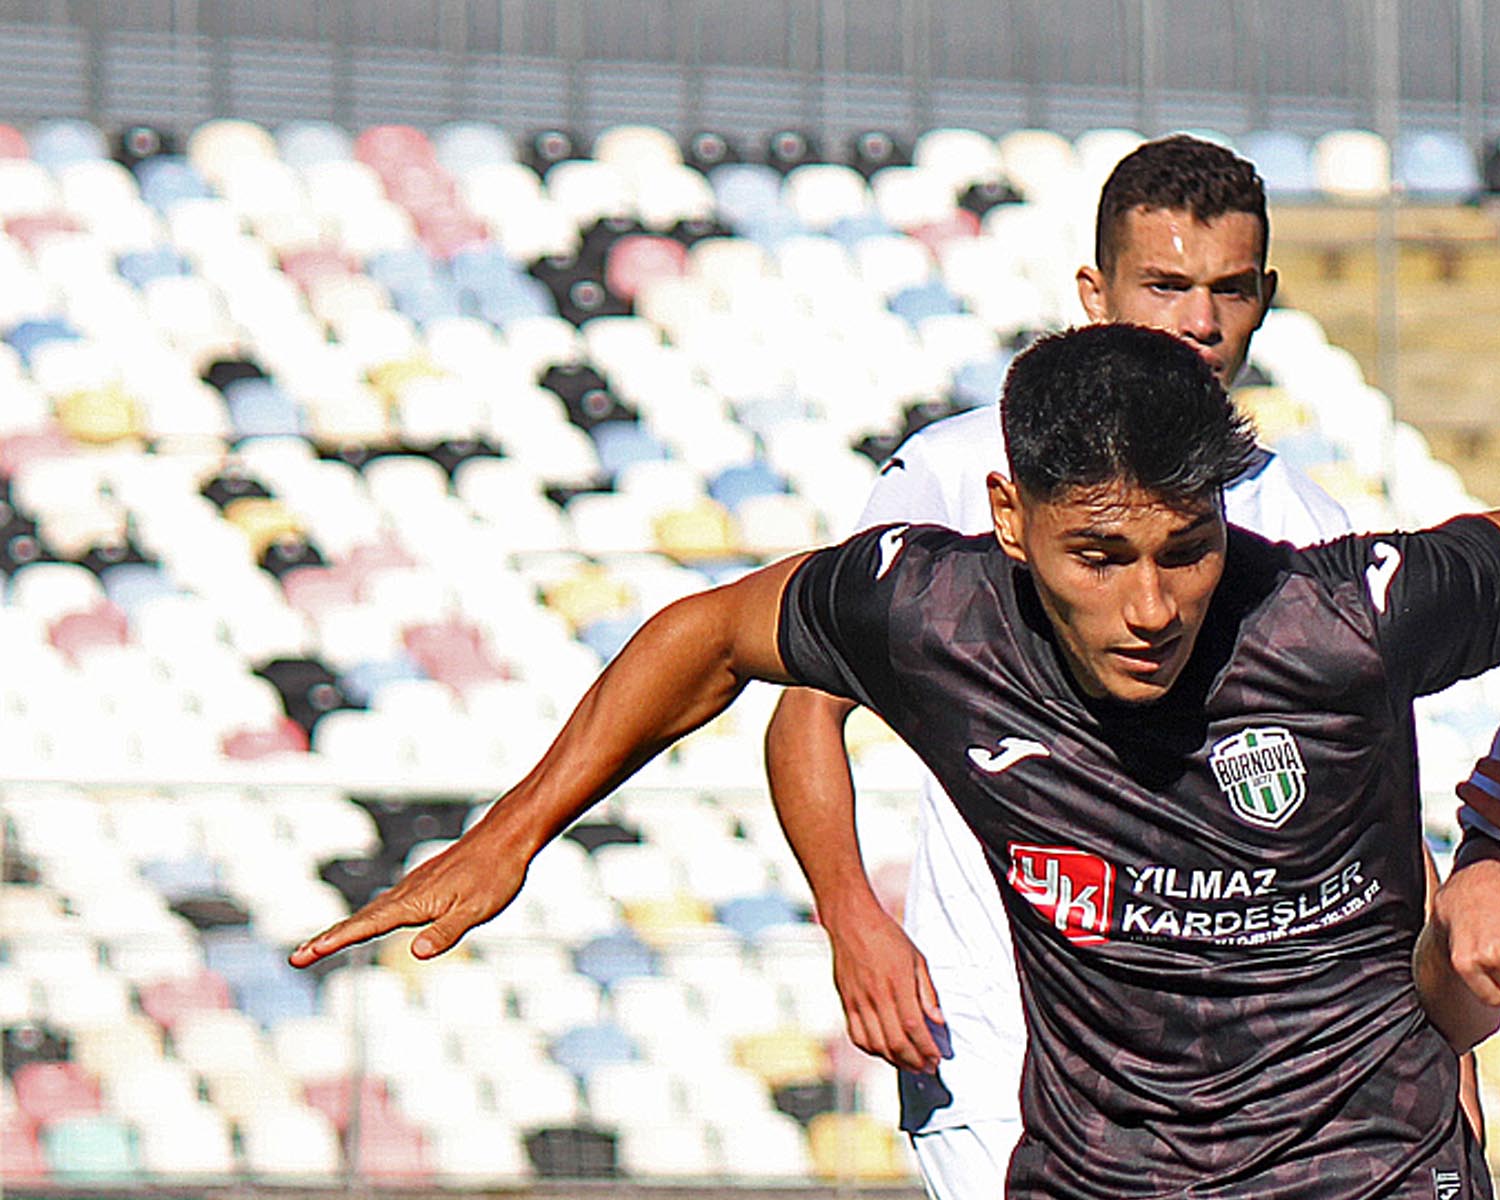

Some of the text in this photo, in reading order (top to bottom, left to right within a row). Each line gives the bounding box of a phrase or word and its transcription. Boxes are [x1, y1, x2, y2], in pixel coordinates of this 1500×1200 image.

[1215, 741, 1300, 786] BORNOVA
[1121, 861, 1365, 937] KARDEŞLER
[1124, 866, 1279, 901] YILMAZ
